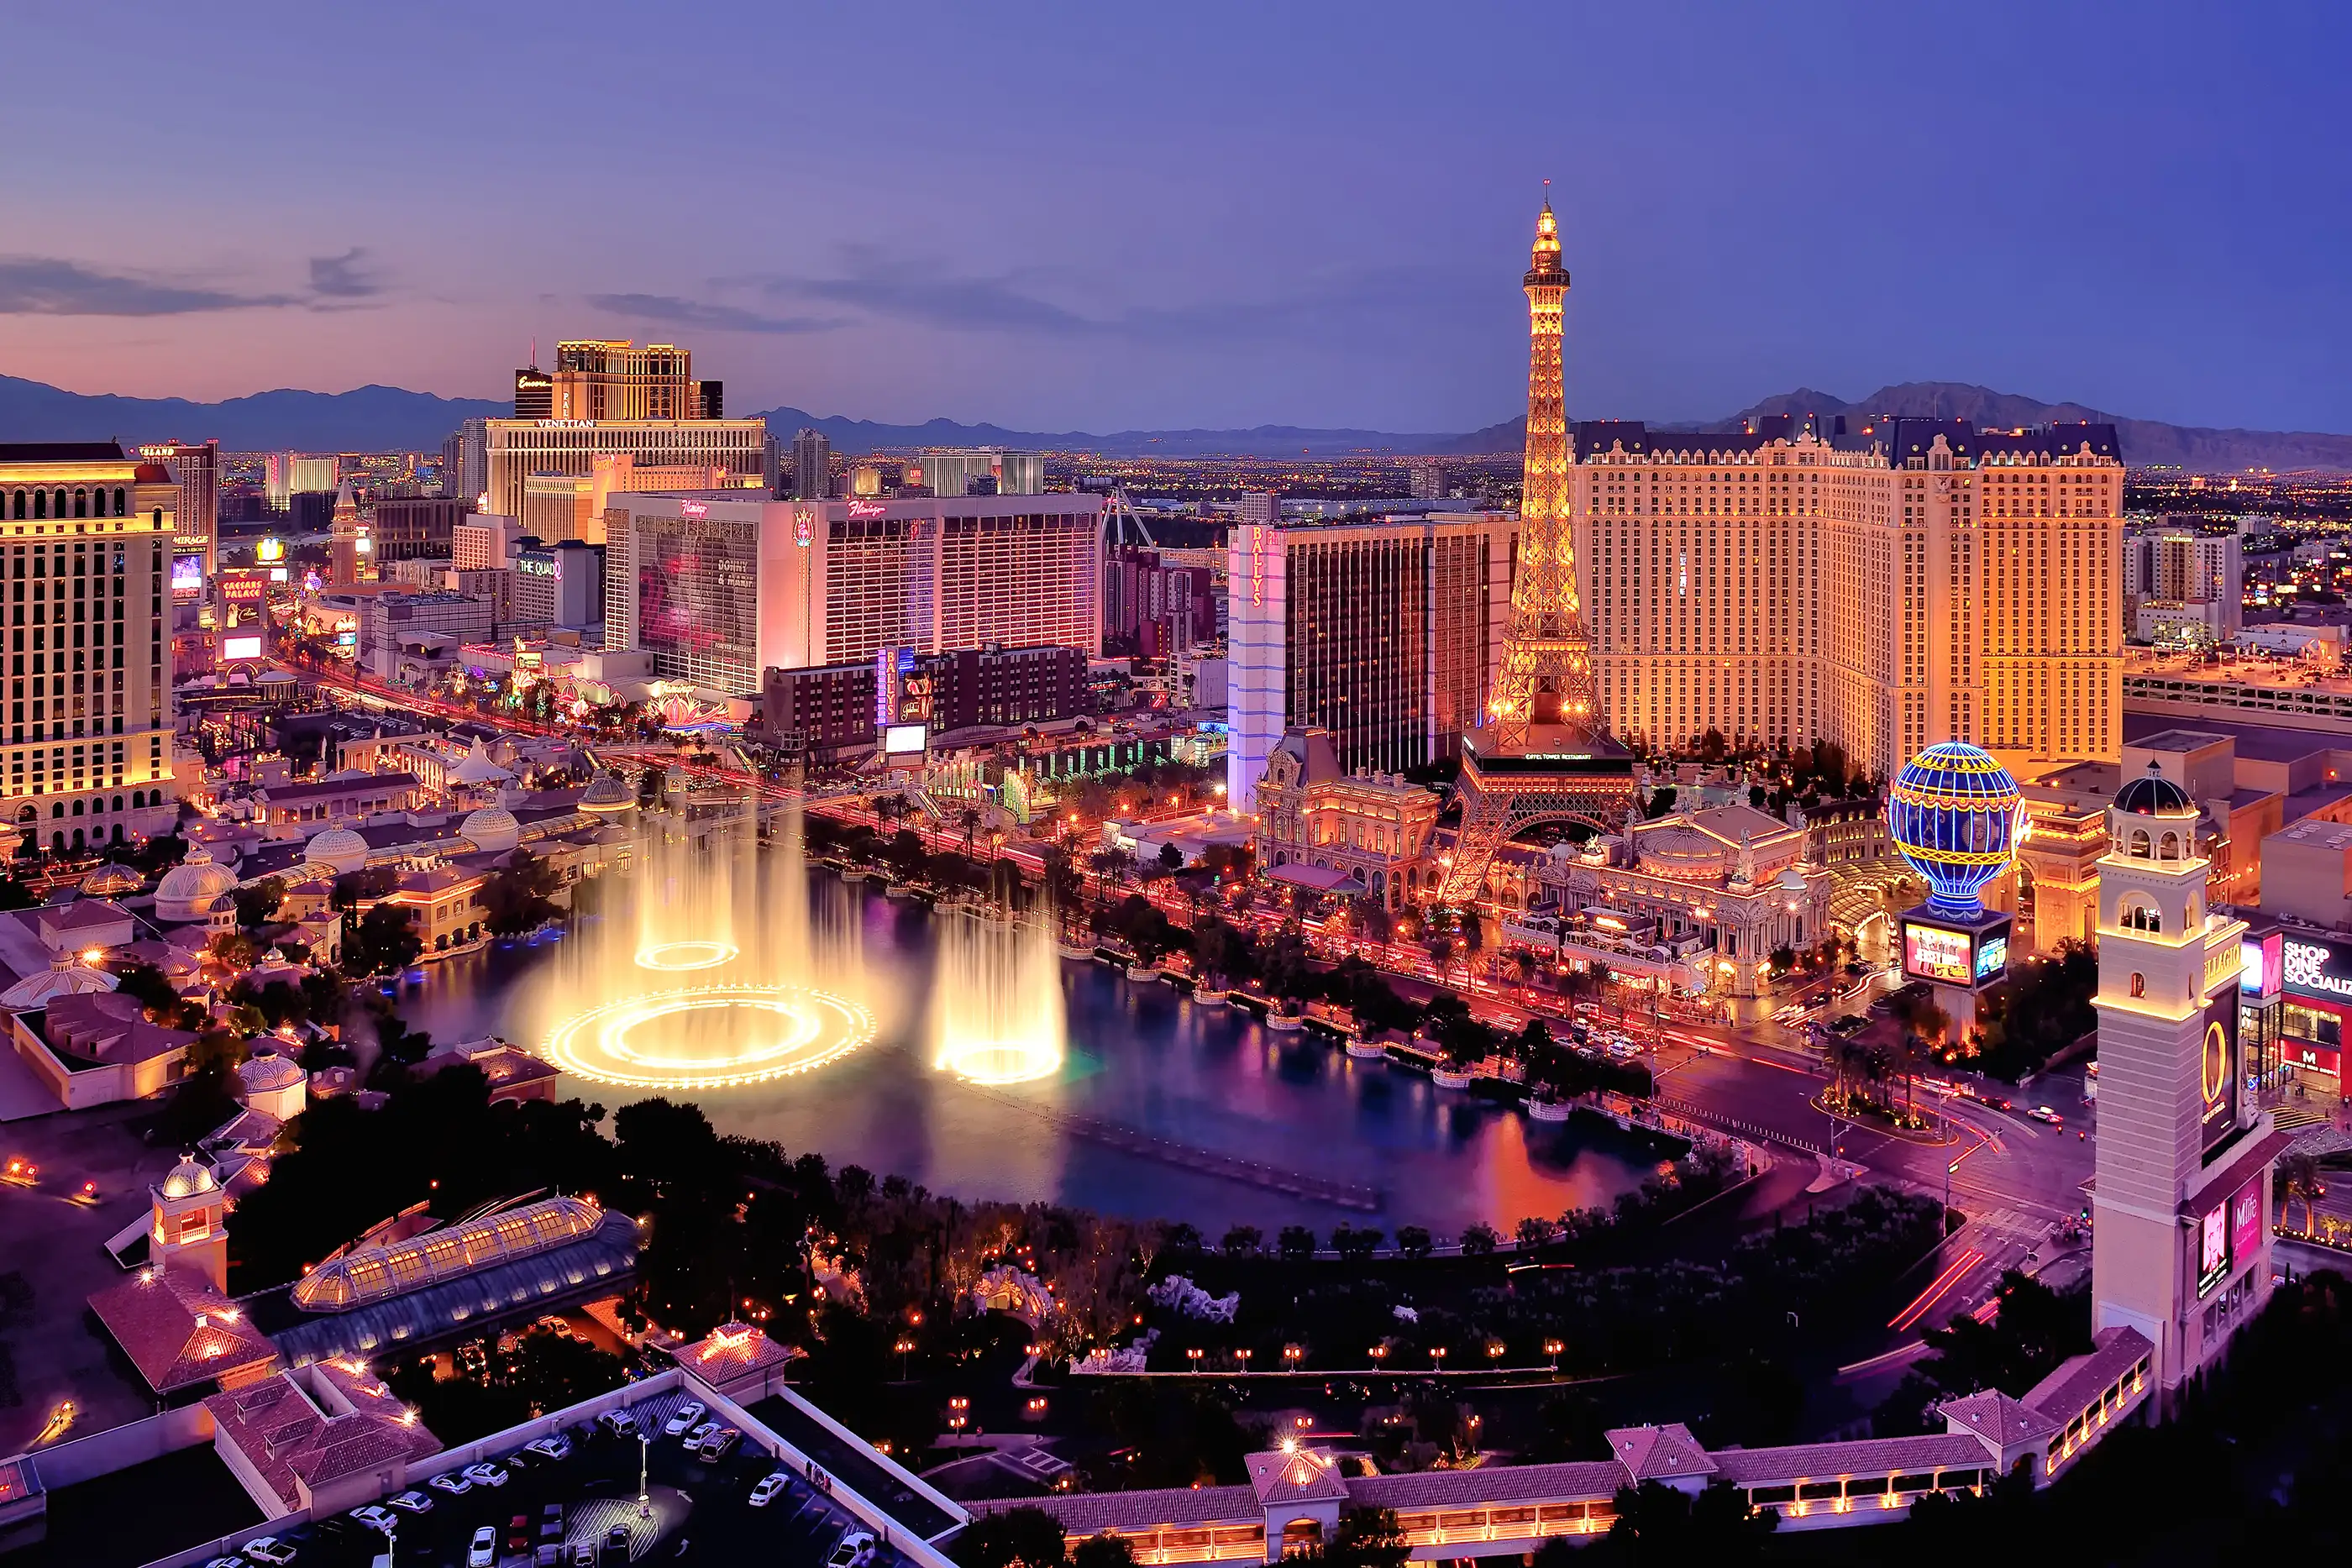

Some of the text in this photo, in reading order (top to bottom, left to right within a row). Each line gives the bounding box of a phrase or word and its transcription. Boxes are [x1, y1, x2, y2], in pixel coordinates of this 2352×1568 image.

[518, 375, 554, 389] Encore
[538, 419, 594, 428] VENETIAN
[681, 499, 708, 519] Flamingo
[848, 500, 885, 517] Flamingo
[172, 535, 209, 545] MIRAGE
[2162, 533, 2193, 543] PLATINUM
[520, 560, 555, 577] THE QUAD
[223, 580, 262, 590] CAESARS
[718, 574, 724, 585] &
[225, 589, 261, 599] PALACE
[2283, 941, 2330, 963] SHOP
[2283, 957, 2322, 977] DINE
[2302, 1050, 2316, 1065] M
